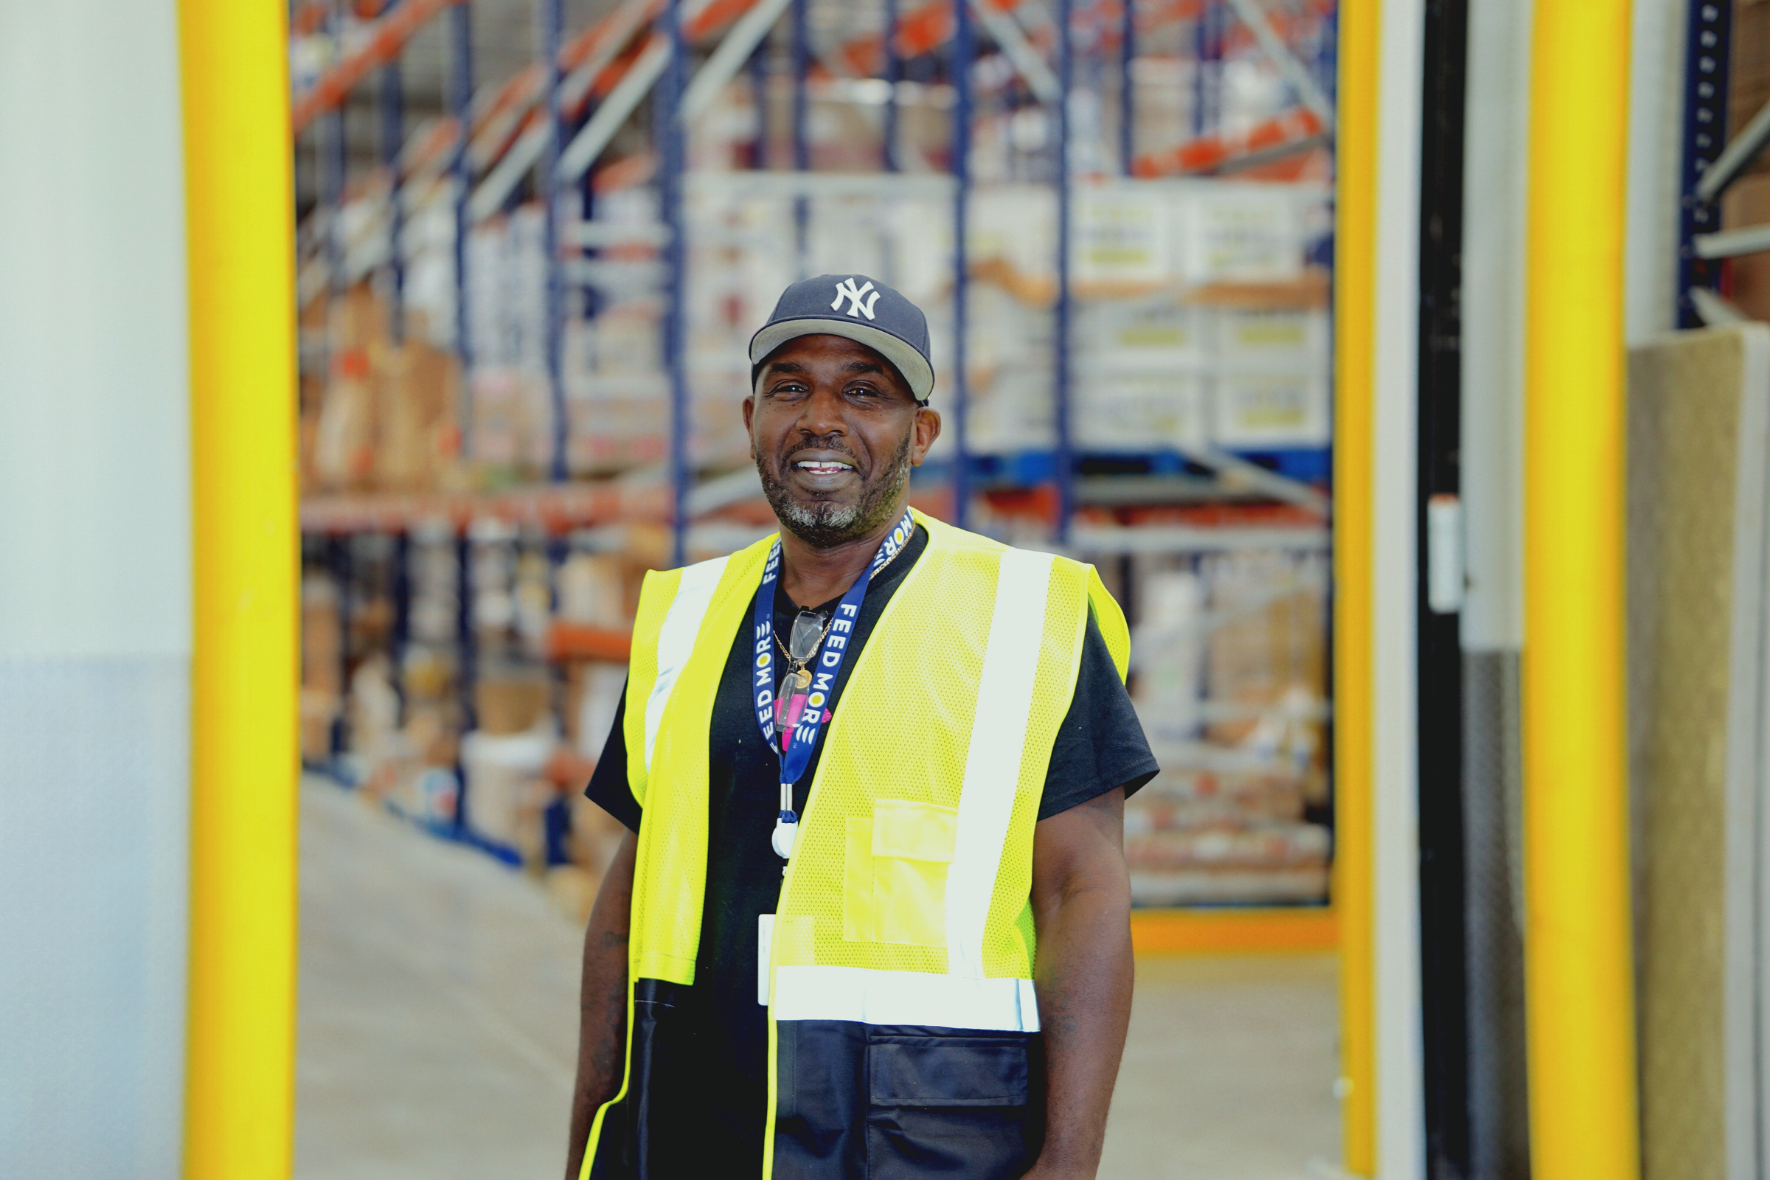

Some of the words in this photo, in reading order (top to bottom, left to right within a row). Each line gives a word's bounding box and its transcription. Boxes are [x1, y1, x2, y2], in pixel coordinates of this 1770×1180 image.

[830, 277, 881, 321] NY
[873, 514, 913, 567] MORE
[756, 620, 772, 687] MORE
[822, 603, 858, 668] FEED
[795, 672, 834, 745] MORE
